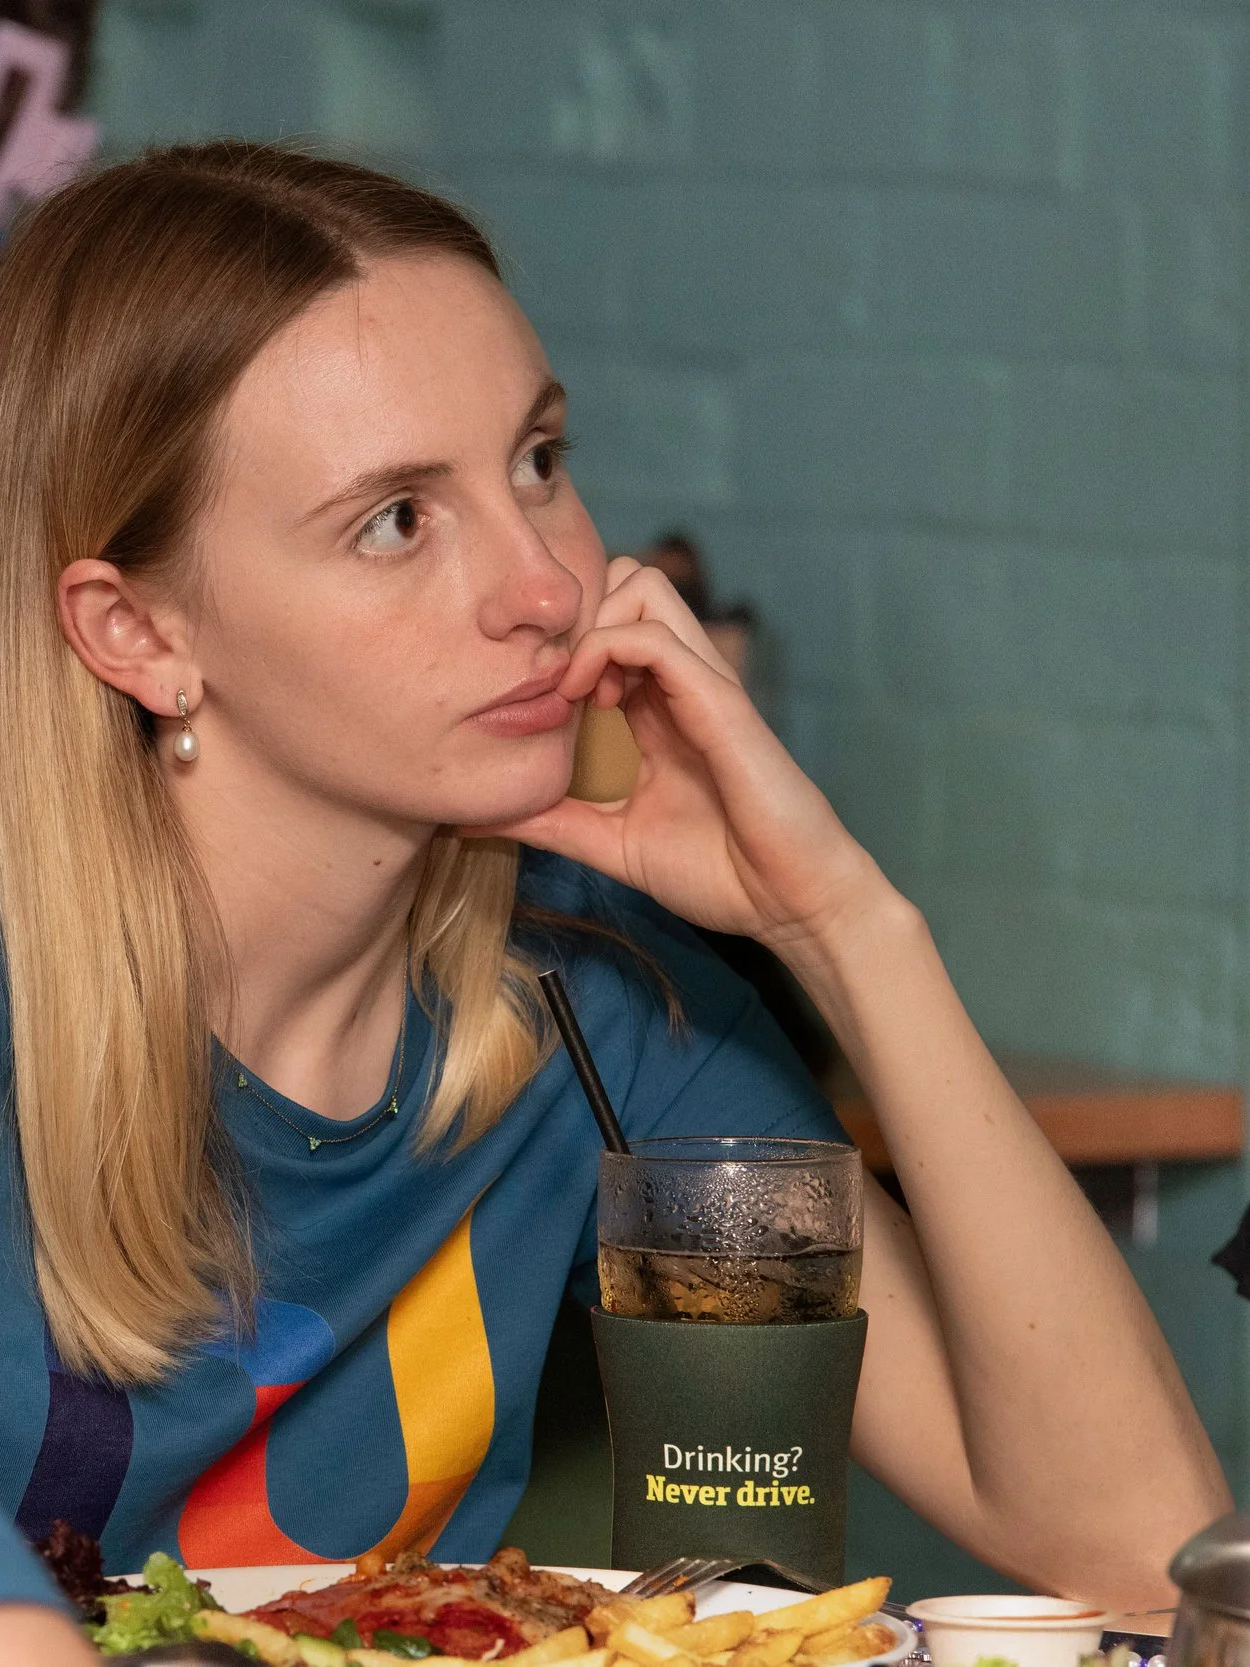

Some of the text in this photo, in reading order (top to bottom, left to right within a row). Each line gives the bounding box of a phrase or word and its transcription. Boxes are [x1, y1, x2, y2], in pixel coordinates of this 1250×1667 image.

[663, 1443, 803, 1479] Drinking?
[645, 1474, 816, 1507] Never drive.
